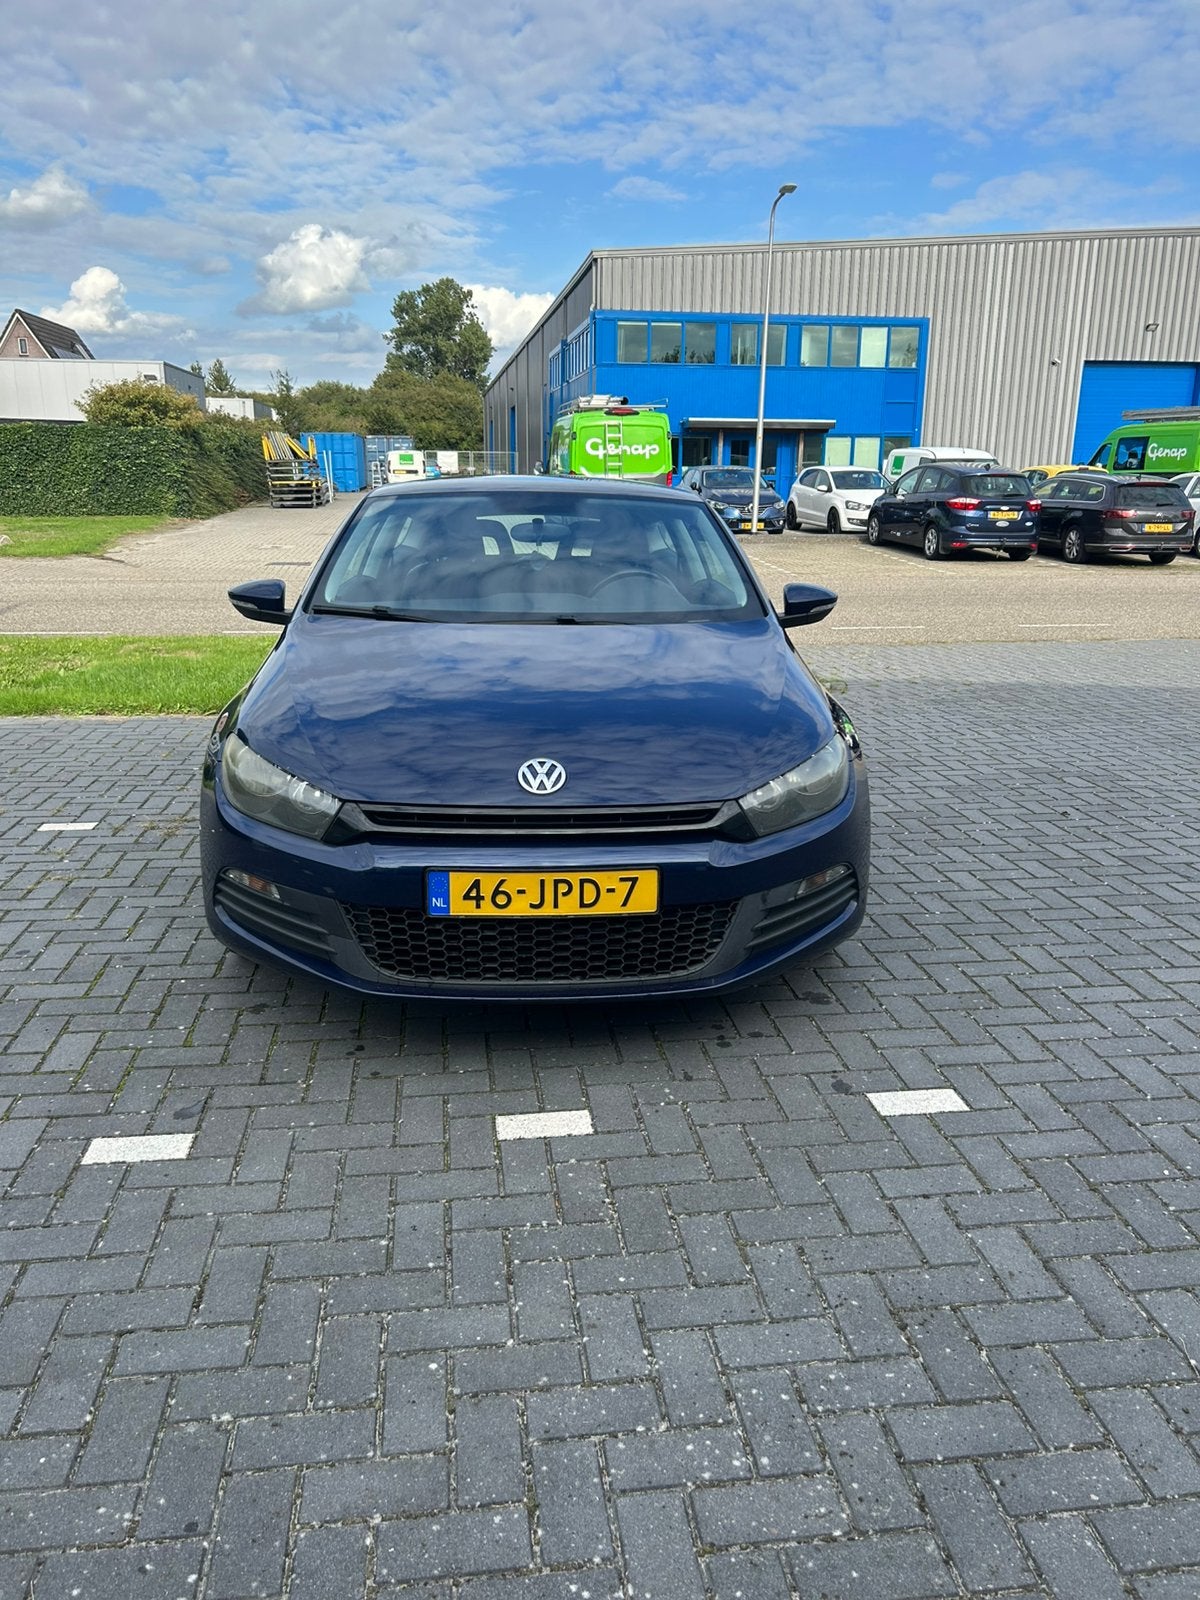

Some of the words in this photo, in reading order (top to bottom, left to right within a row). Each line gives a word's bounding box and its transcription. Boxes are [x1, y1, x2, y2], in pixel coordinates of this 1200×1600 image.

[585, 438, 660, 459] Genap
[1147, 443, 1188, 461] Genap
[518, 757, 567, 795] VW
[431, 897, 447, 908] NL
[462, 876, 640, 910] 46-JPD-7
